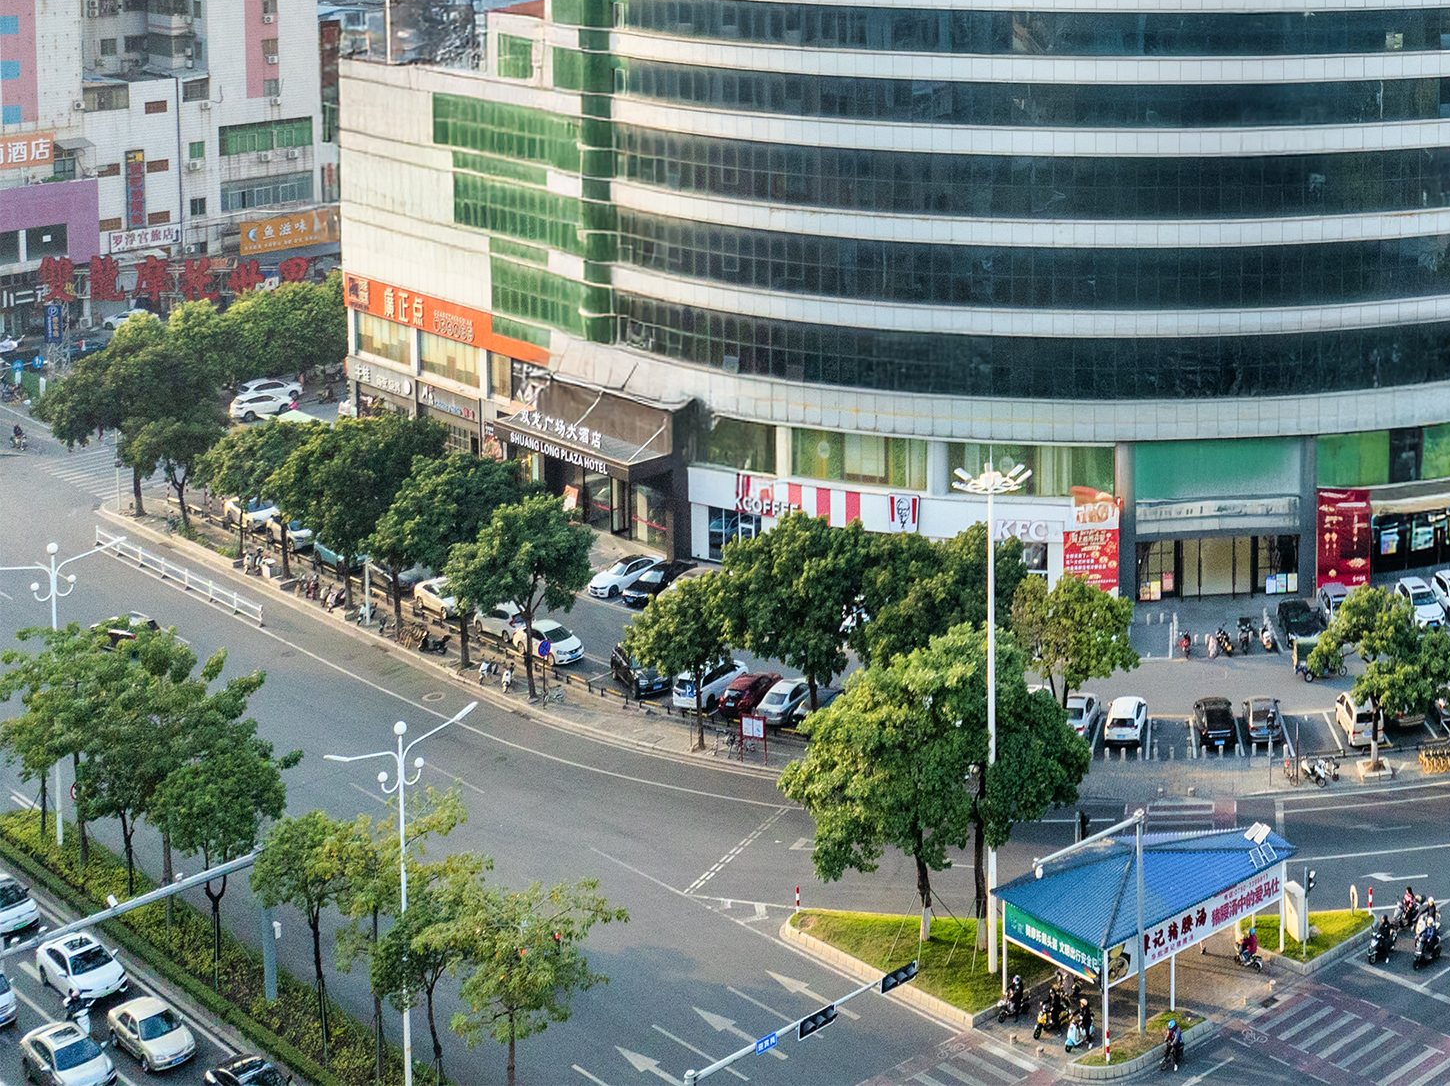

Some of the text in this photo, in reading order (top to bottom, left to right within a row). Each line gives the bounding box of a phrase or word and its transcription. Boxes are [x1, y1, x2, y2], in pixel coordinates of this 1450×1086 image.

[520, 410, 602, 449] 双龙广场大酒店
[510, 432, 609, 475] SHUANG LONG PLAZA HOTEL
[995, 519, 1048, 541] KFC
[1211, 877, 1280, 928] 猪腰汤中的爱马仕
